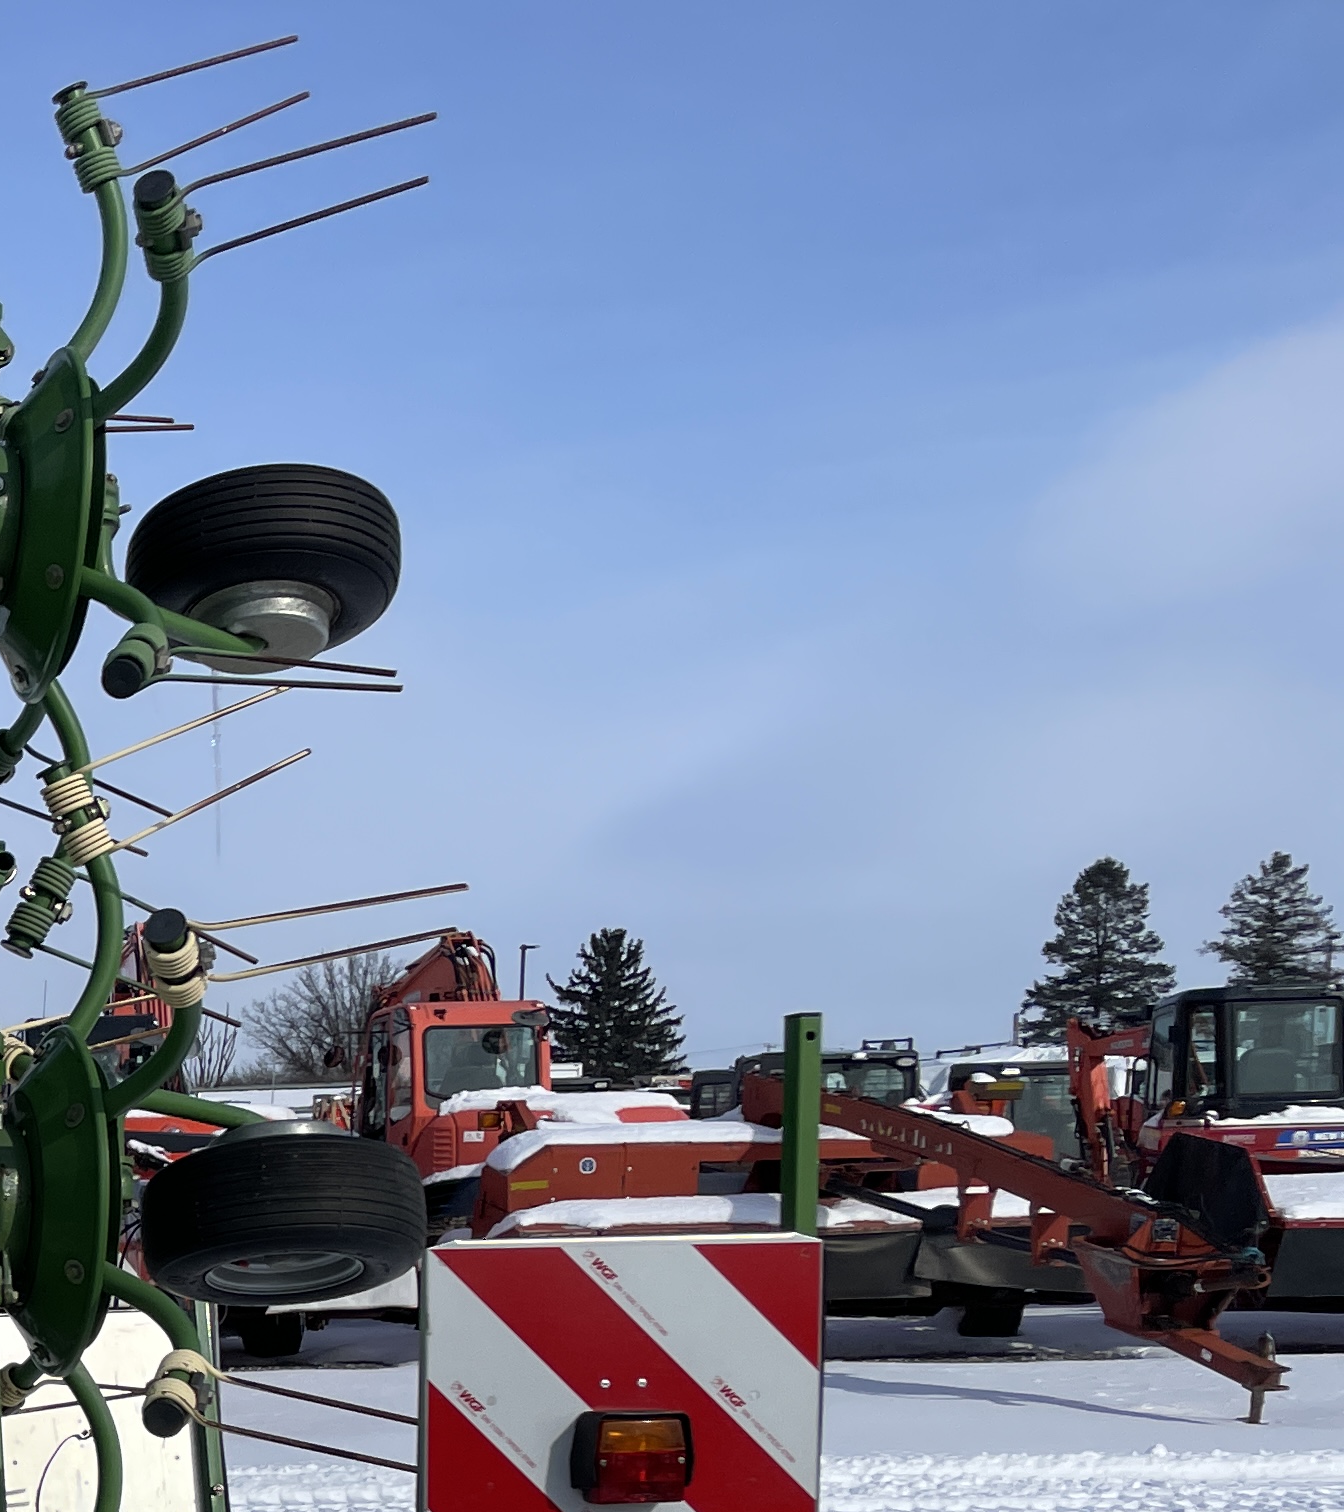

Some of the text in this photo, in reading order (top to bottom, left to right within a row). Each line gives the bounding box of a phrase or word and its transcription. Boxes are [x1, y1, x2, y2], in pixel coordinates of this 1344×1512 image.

[592, 1257, 619, 1280] WGF
[459, 1389, 487, 1412] WGF
[719, 1385, 747, 1408] WGF
